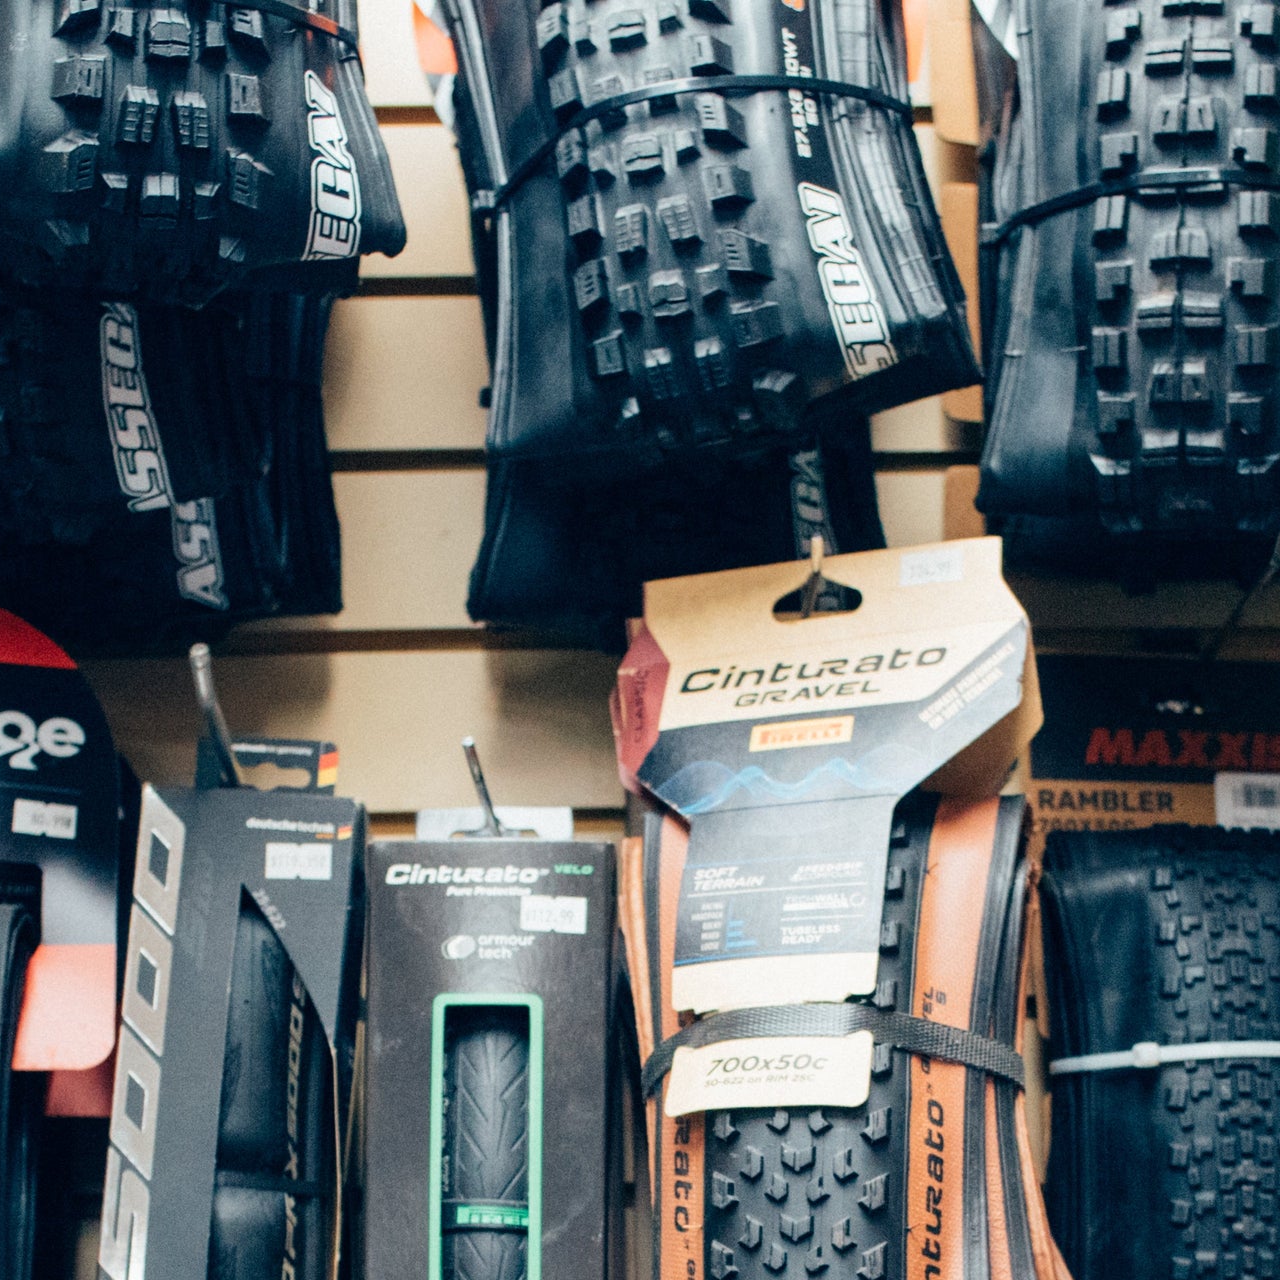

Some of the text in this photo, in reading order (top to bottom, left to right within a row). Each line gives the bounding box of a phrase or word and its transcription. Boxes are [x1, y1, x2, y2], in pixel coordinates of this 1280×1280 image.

[679, 646, 950, 694] Cinturato
[734, 678, 881, 709] GRAVEL
[759, 722, 844, 747] PIRELLI
[1038, 789, 1175, 815] RAMBLER
[384, 863, 595, 886] Cinturato VELO
[693, 876, 765, 891] TERRAIN
[694, 866, 739, 881] SOFT
[478, 934, 536, 947] armour
[478, 946, 513, 961] tech
[706, 1053, 829, 1076] 700x50c
